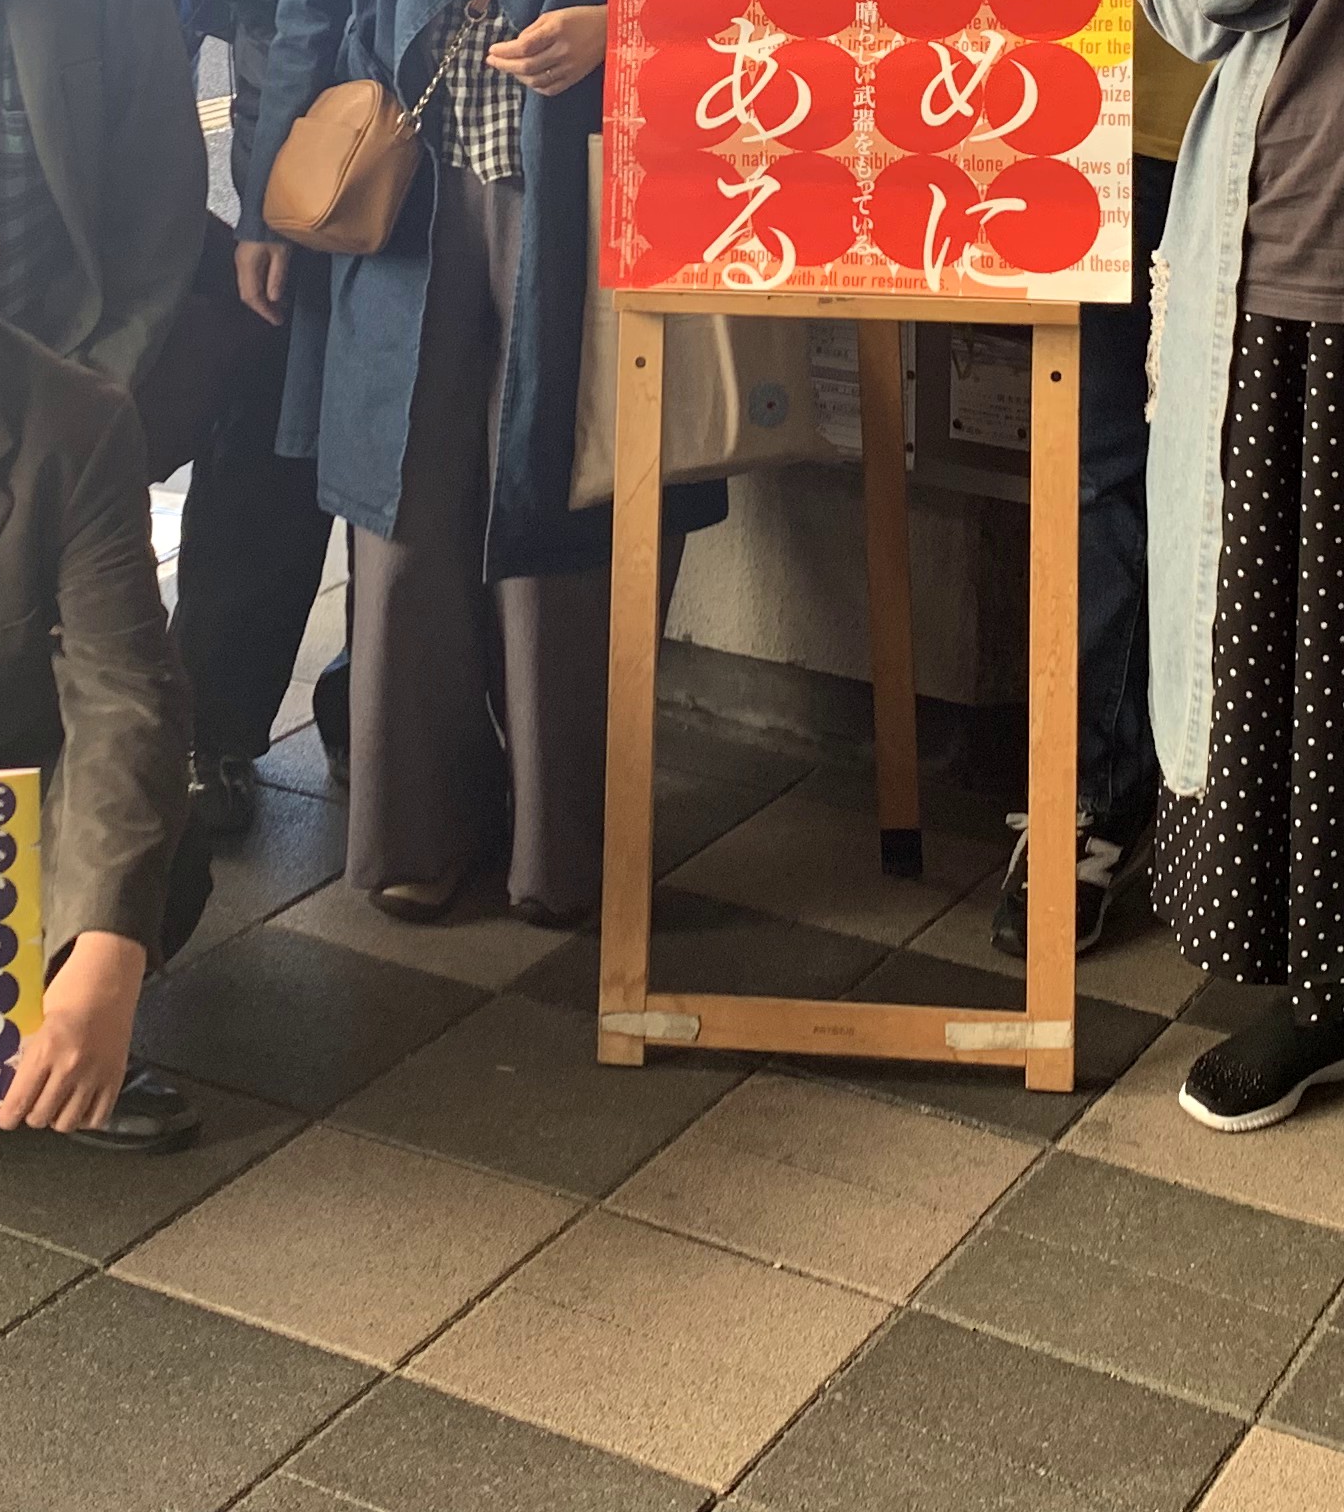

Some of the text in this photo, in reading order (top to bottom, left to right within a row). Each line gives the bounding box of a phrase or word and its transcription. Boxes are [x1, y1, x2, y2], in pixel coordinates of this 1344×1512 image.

[1118, 15, 1132, 32] to
[1080, 38, 1131, 55] for the
[1076, 157, 1112, 176] laws
[1117, 158, 1132, 176] of
[1117, 183, 1131, 200] is
[1090, 253, 1131, 273] these
[682, 269, 709, 286] and
[786, 270, 816, 288] with
[820, 270, 838, 287] all
[842, 273, 865, 288] our
